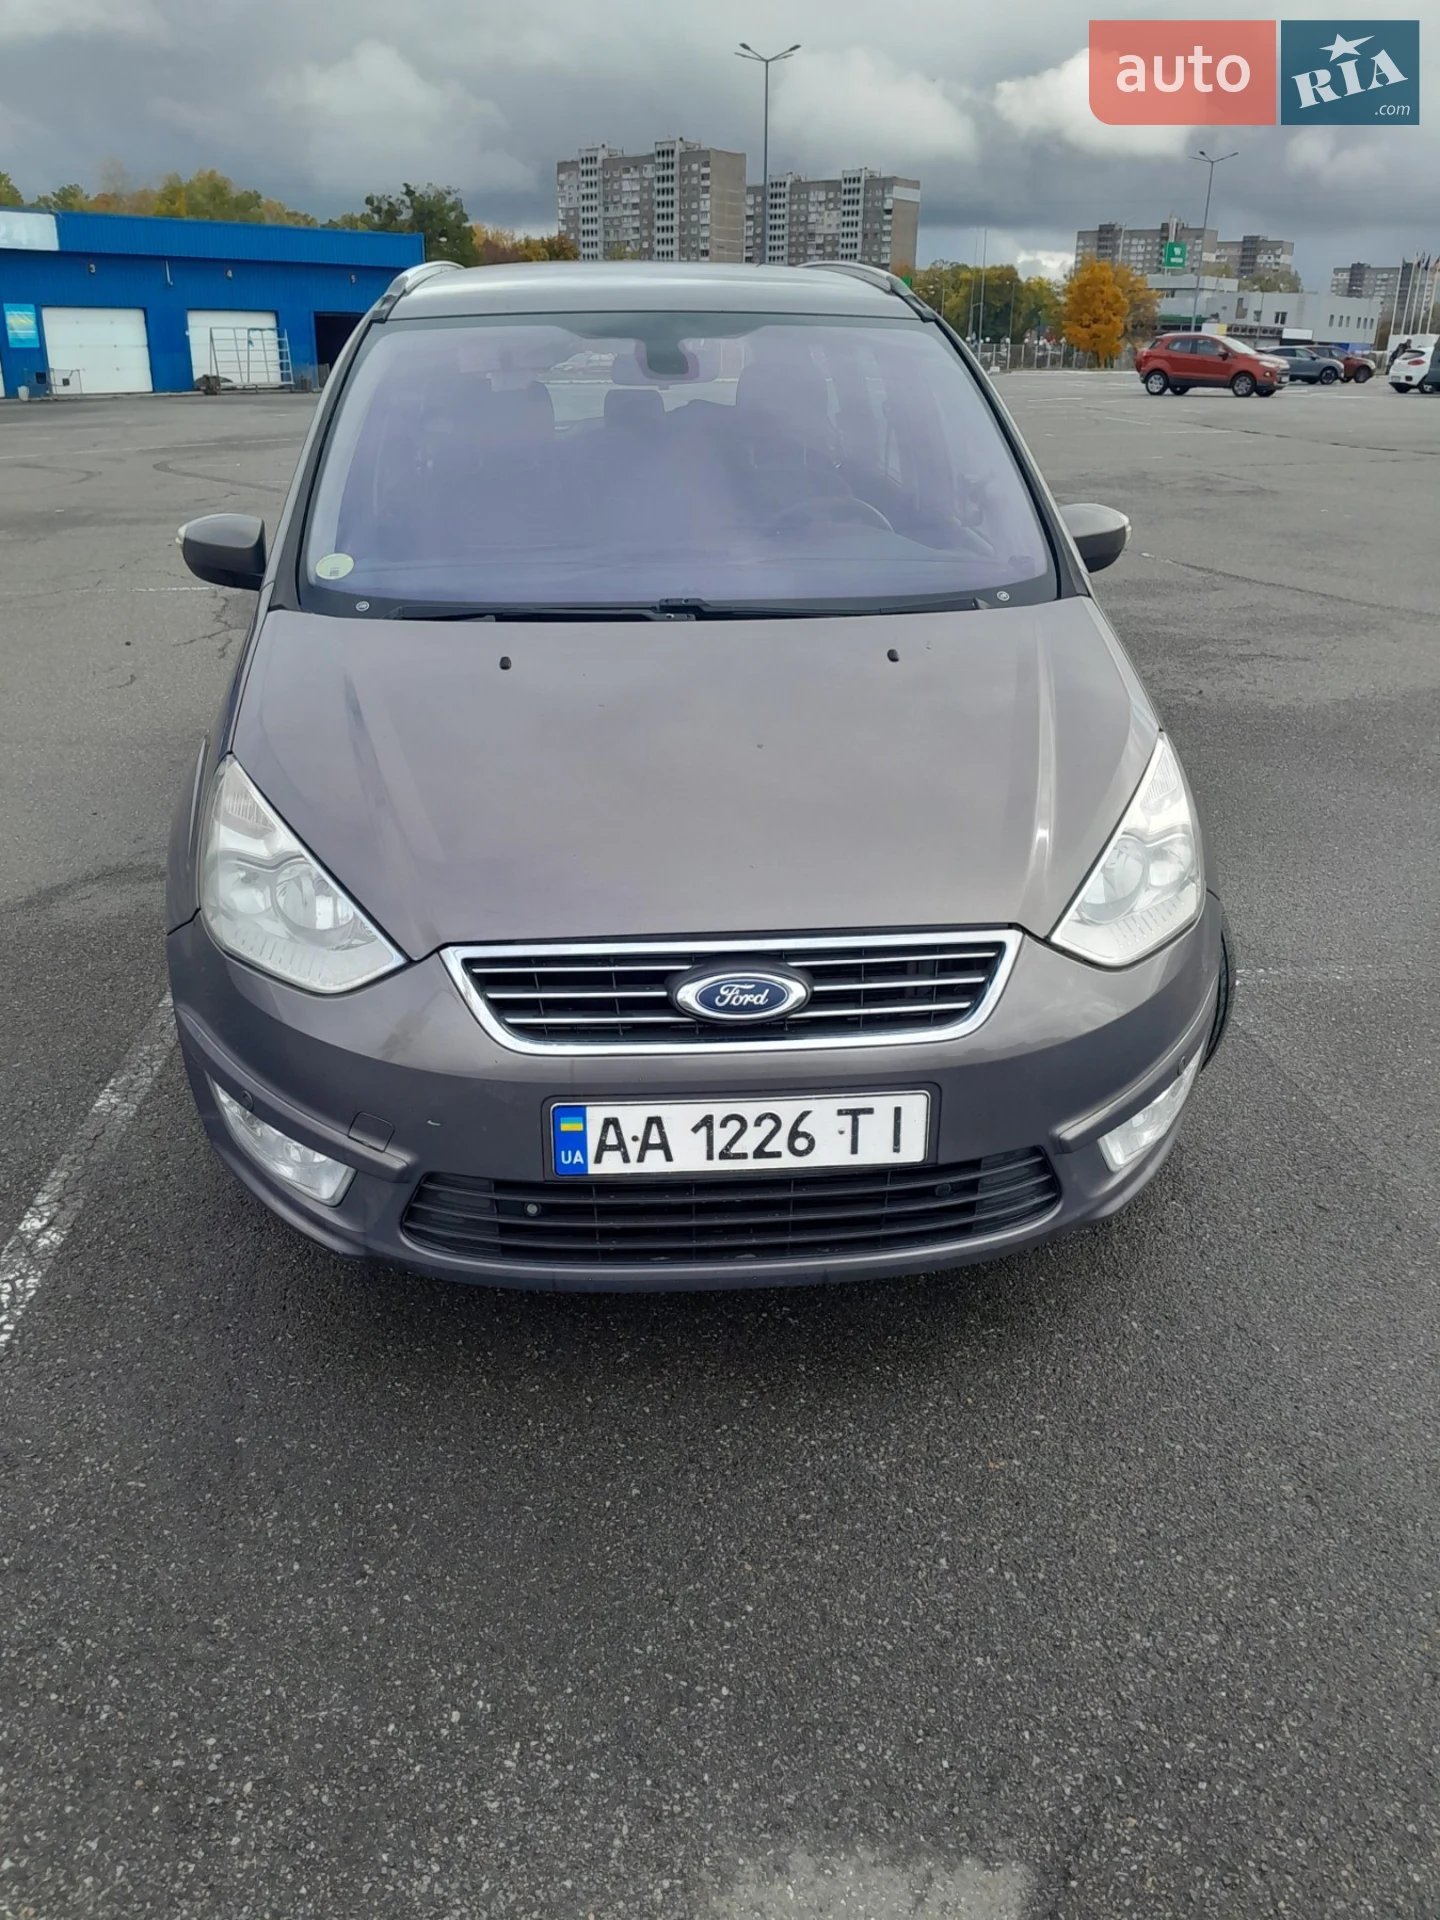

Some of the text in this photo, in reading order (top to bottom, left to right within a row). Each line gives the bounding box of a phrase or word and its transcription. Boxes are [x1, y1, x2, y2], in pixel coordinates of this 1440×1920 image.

[715, 984, 769, 1006] Ford
[594, 1116, 674, 1164] AA
[690, 1110, 816, 1161] 1226
[561, 1151, 584, 1165] UA
